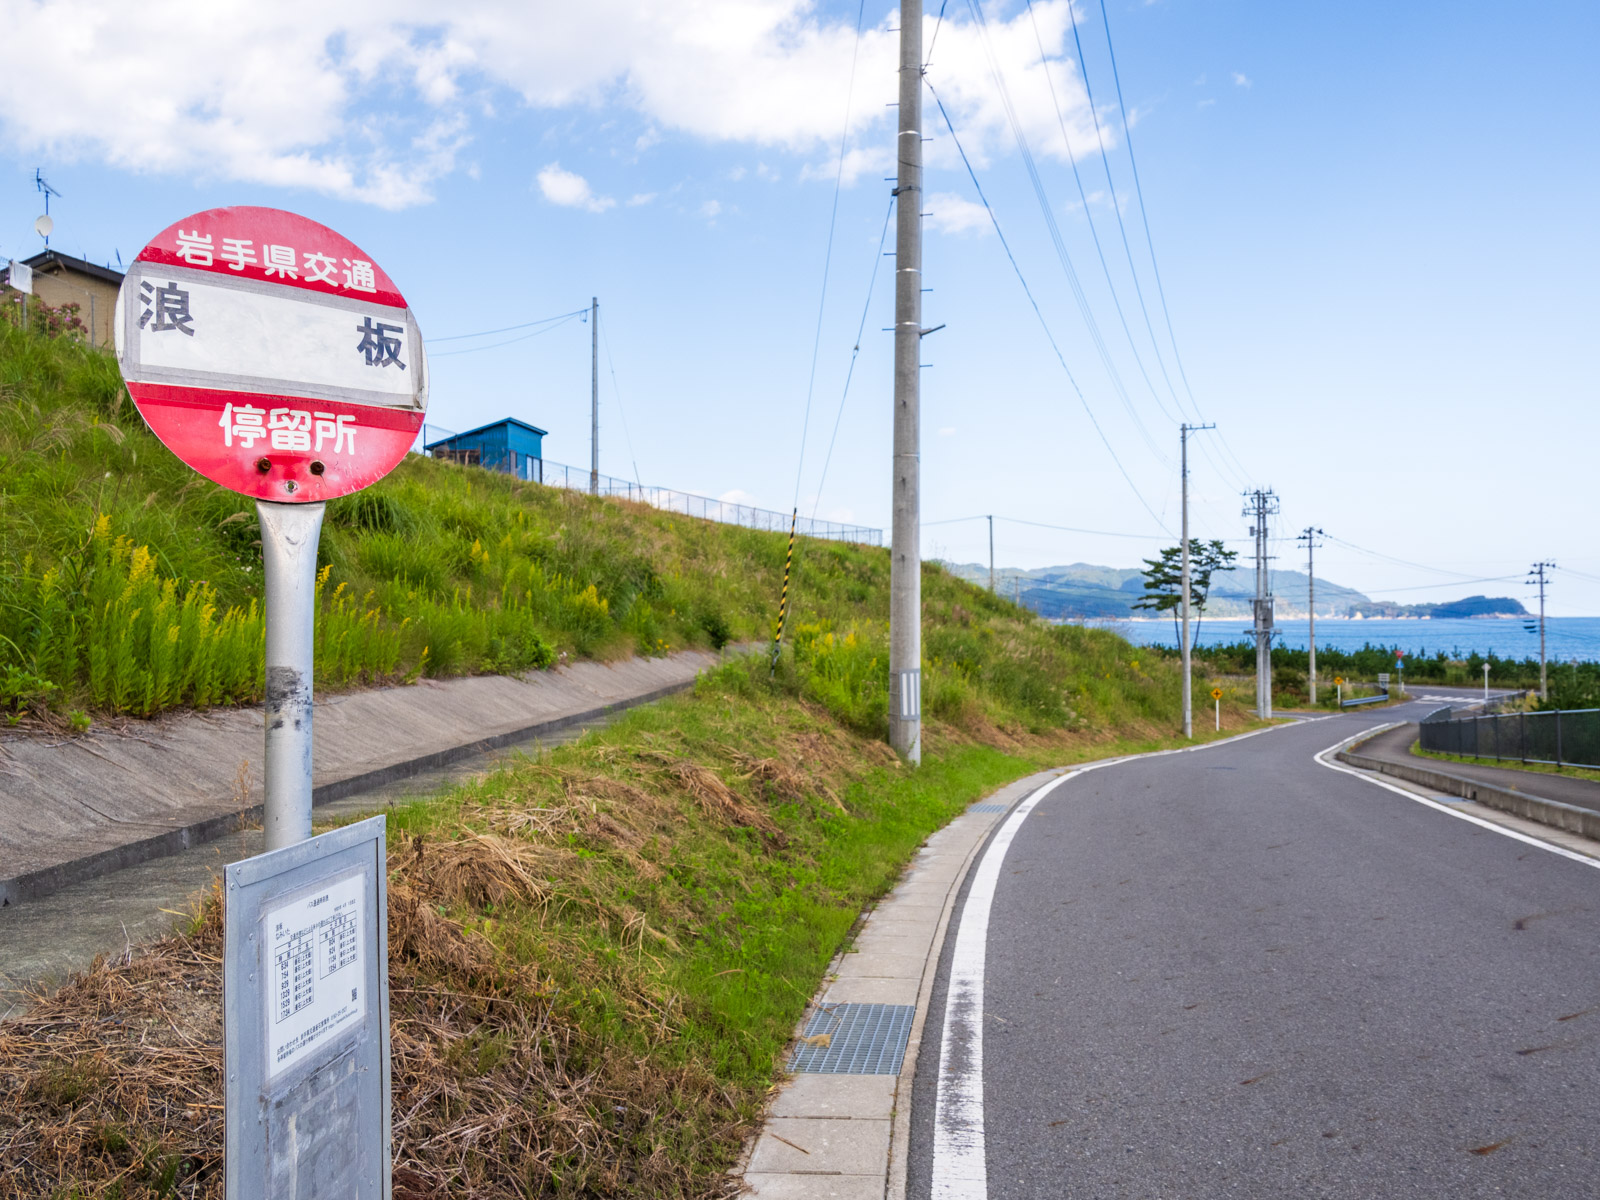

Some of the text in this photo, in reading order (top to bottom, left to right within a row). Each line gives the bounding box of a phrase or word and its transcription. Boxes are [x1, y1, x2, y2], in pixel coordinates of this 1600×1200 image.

[175, 229, 377, 294] 岩手県交通
[218, 402, 357, 455] 停留所
